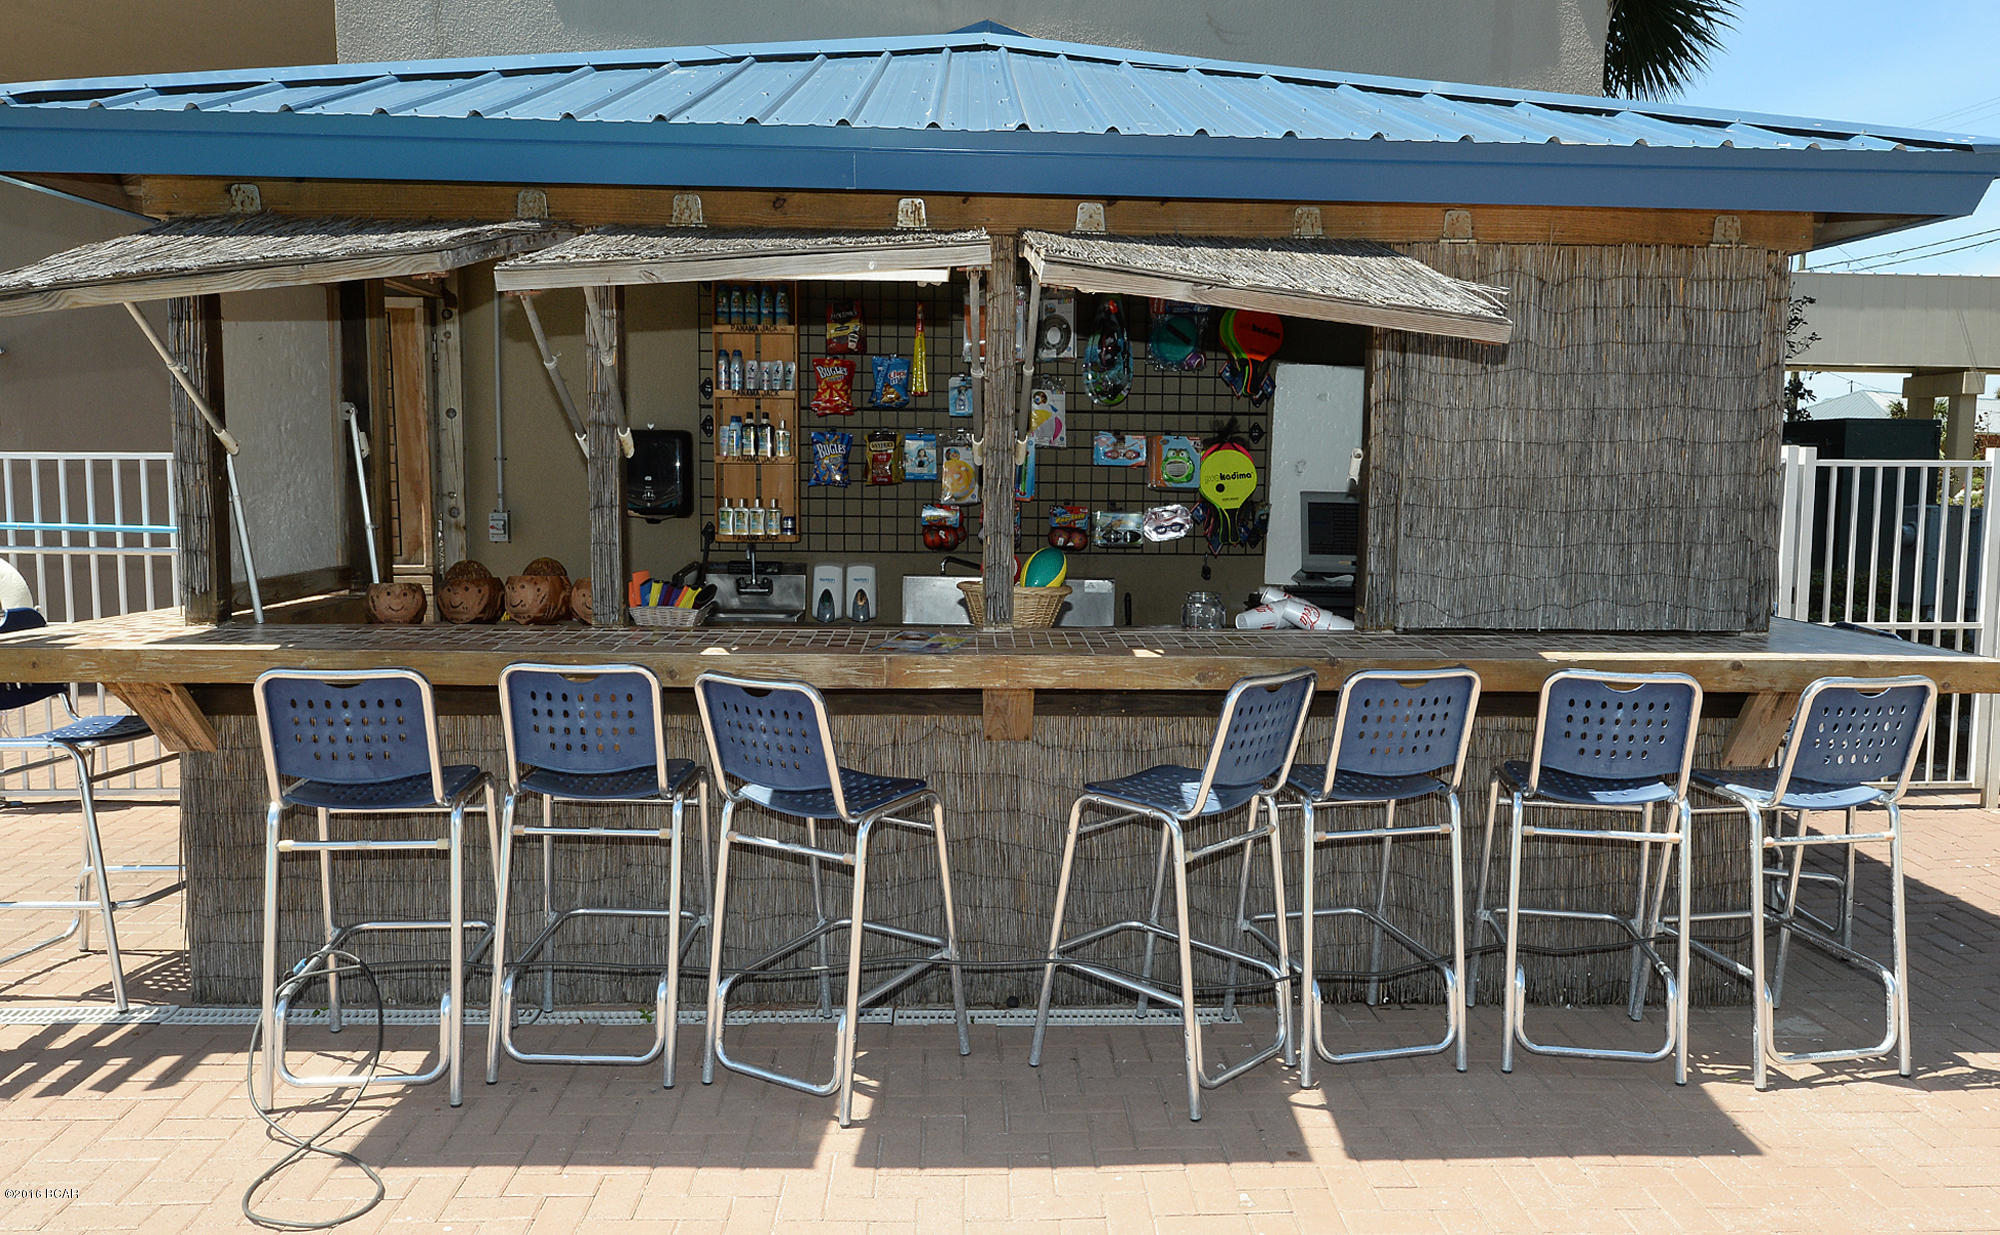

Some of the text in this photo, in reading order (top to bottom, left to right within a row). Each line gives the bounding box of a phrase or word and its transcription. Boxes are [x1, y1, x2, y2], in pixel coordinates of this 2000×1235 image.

[731, 324, 778, 333] PANAMA JACK
[816, 365, 848, 379] BUGLES
[731, 388, 780, 397] PANAMA JACK
[816, 442, 846, 459] BUGLES
[731, 455, 760, 464] PANAMA
[1219, 471, 1252, 481] kadima
